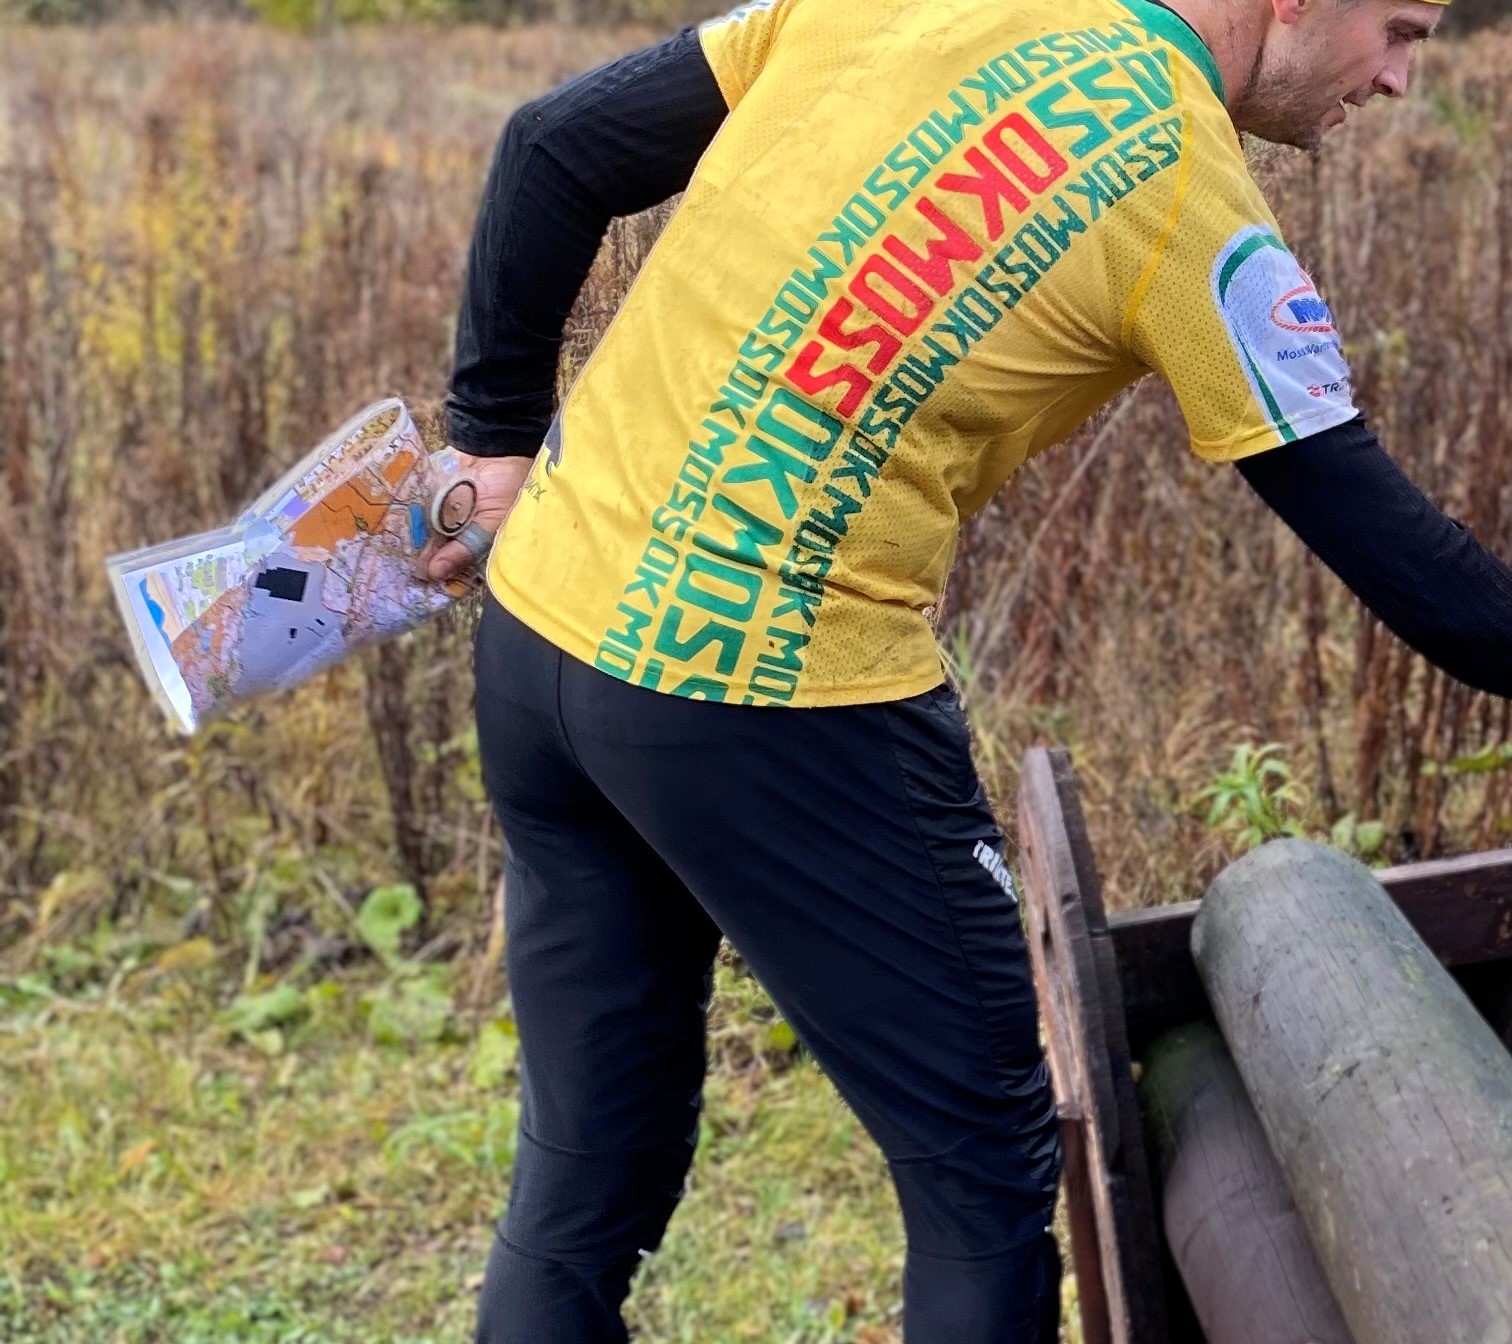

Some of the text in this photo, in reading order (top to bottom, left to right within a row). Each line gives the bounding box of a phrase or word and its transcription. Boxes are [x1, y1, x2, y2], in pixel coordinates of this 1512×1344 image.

[960, 51, 1037, 116] OK
[1025, 47, 1177, 159] OSS
[861, 88, 985, 212] MOSS
[935, 112, 1069, 243] OK
[1064, 153, 1136, 223] OK
[816, 193, 887, 267] OK
[975, 193, 1089, 310] MOSS
[738, 246, 845, 373] MOSS
[784, 196, 984, 420] MOSS
[930, 286, 1003, 357] OK
[707, 359, 769, 430] OK
[857, 335, 961, 449] MOSS
[652, 418, 740, 542] MOSS
[722, 387, 845, 521] OK
[624, 536, 680, 610] OK
